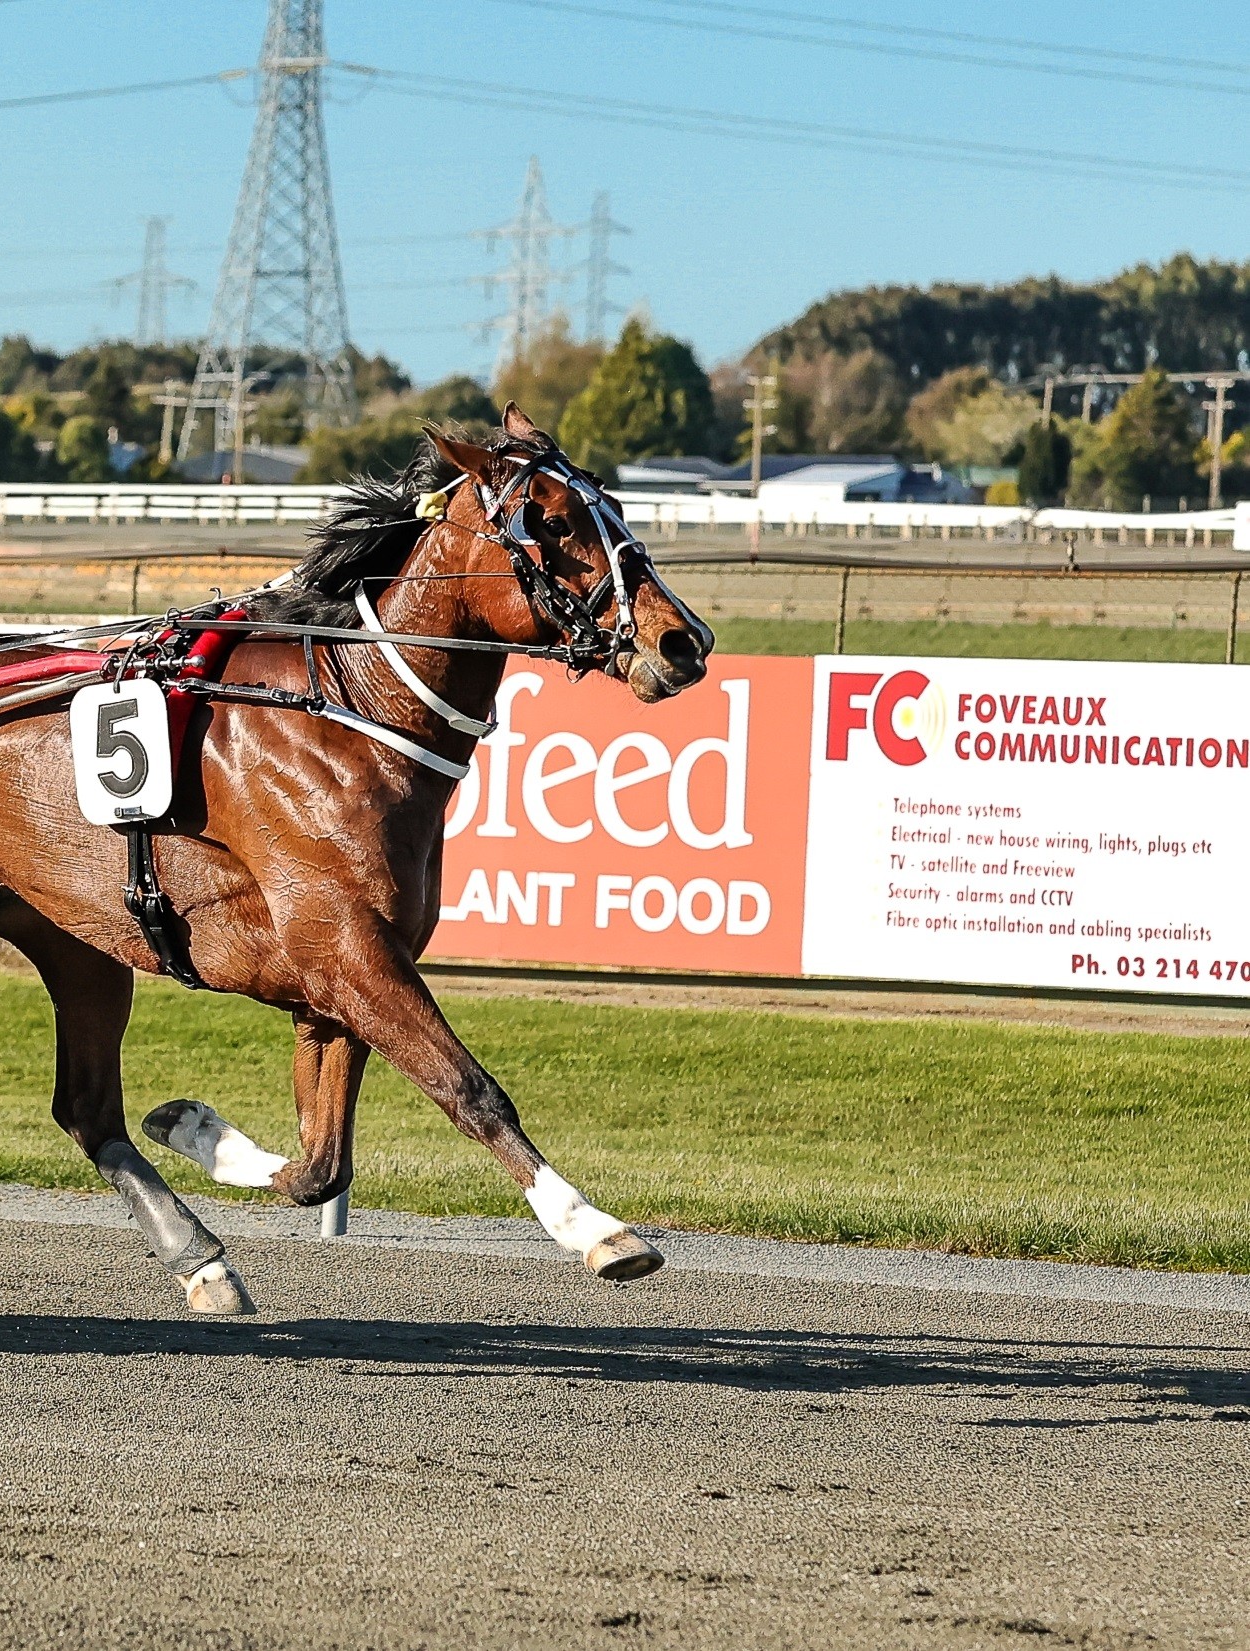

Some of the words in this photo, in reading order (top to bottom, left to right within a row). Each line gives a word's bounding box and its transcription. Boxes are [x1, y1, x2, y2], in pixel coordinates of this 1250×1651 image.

[824, 669, 931, 767] FC
[957, 693, 1107, 727] FOVEAUX
[96, 698, 149, 799] 5
[954, 730, 1250, 769] COMMUNICATION
[893, 796, 962, 818] Telephone
[967, 803, 1022, 820] systems
[891, 824, 951, 844] Electrical
[966, 834, 995, 846] new
[999, 829, 1040, 848] house
[1045, 831, 1093, 854] wiring,
[1099, 832, 1142, 855] lights,
[1147, 834, 1187, 858] plugs
[1192, 839, 1212, 855] etc
[890, 853, 906, 870] TV
[921, 855, 977, 874] satellite
[982, 857, 1008, 875] and
[1013, 859, 1076, 878] Freeview
[439, 868, 576, 927] ANT
[595, 874, 771, 936] FOOD
[887, 882, 941, 904] Security
[956, 884, 1004, 904] alarms
[1009, 887, 1036, 906] and
[1040, 889, 1074, 907] CCTV
[886, 910, 920, 929] Fibre
[925, 912, 958, 933] optic
[963, 913, 1044, 934] installation
[1048, 918, 1076, 936] and
[1080, 919, 1132, 943] cabling
[1137, 922, 1212, 943] specialists
[1071, 953, 1107, 976] Ph.
[1116, 955, 1146, 978] 03
[1155, 957, 1200, 980] 214
[1208, 959, 1250, 983] 470
